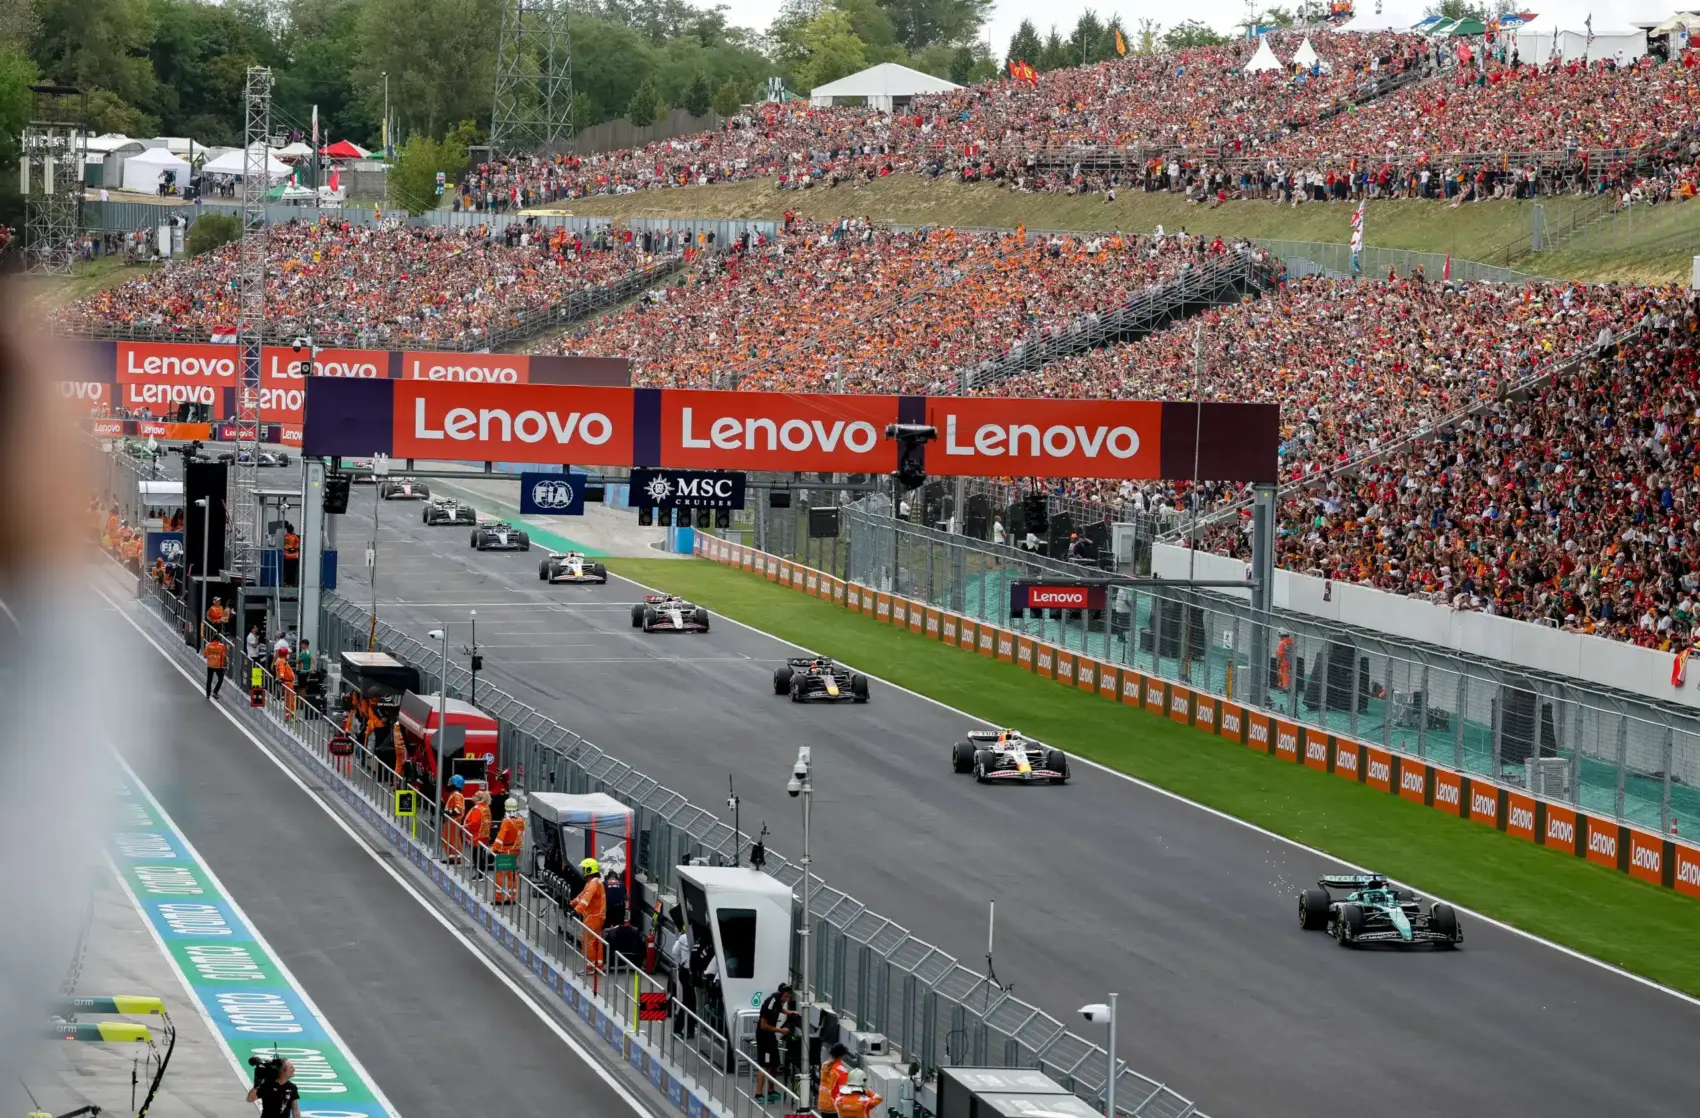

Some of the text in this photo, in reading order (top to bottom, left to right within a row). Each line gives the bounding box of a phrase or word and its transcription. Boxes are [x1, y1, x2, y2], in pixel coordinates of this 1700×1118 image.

[128, 351, 234, 376] Lenovo
[272, 356, 377, 378] Lenovo
[414, 361, 517, 383] Lenovo
[131, 384, 214, 405] Lenovo
[244, 388, 305, 410] Leno
[95, 423, 120, 433] Lenovo
[282, 428, 303, 440] Lenov
[415, 398, 612, 445] Lenovo
[682, 407, 877, 454] Lenovo
[946, 414, 1140, 459] Lenovo
[676, 478, 732, 497] MSC
[1034, 591, 1082, 602] Lenovo
[1124, 676, 1139, 698] Lenovo
[1147, 683, 1163, 706] Lenovo
[1172, 691, 1188, 714] Lenovo
[1197, 700, 1213, 724] Lenovo
[1222, 709, 1239, 733] Lenovo
[1249, 718, 1267, 743] Lenovo
[1277, 727, 1296, 752] Lenovo
[1306, 736, 1326, 761] Lenovo
[1337, 745, 1357, 771] Lenovo
[1368, 755, 1389, 781] Lenovo
[1401, 766, 1423, 793] Lenovo
[1436, 777, 1459, 805] Lenovo
[1472, 788, 1495, 817] Lenovo
[1509, 801, 1533, 830] Lenovo
[1548, 812, 1573, 843] Lenovo
[1589, 825, 1615, 857] Lenovo
[1632, 839, 1660, 872] Lenovo
[1677, 854, 1700, 886] Lenov
[215, 993, 303, 1033] aramco
[57, 1025, 77, 1033] arm
